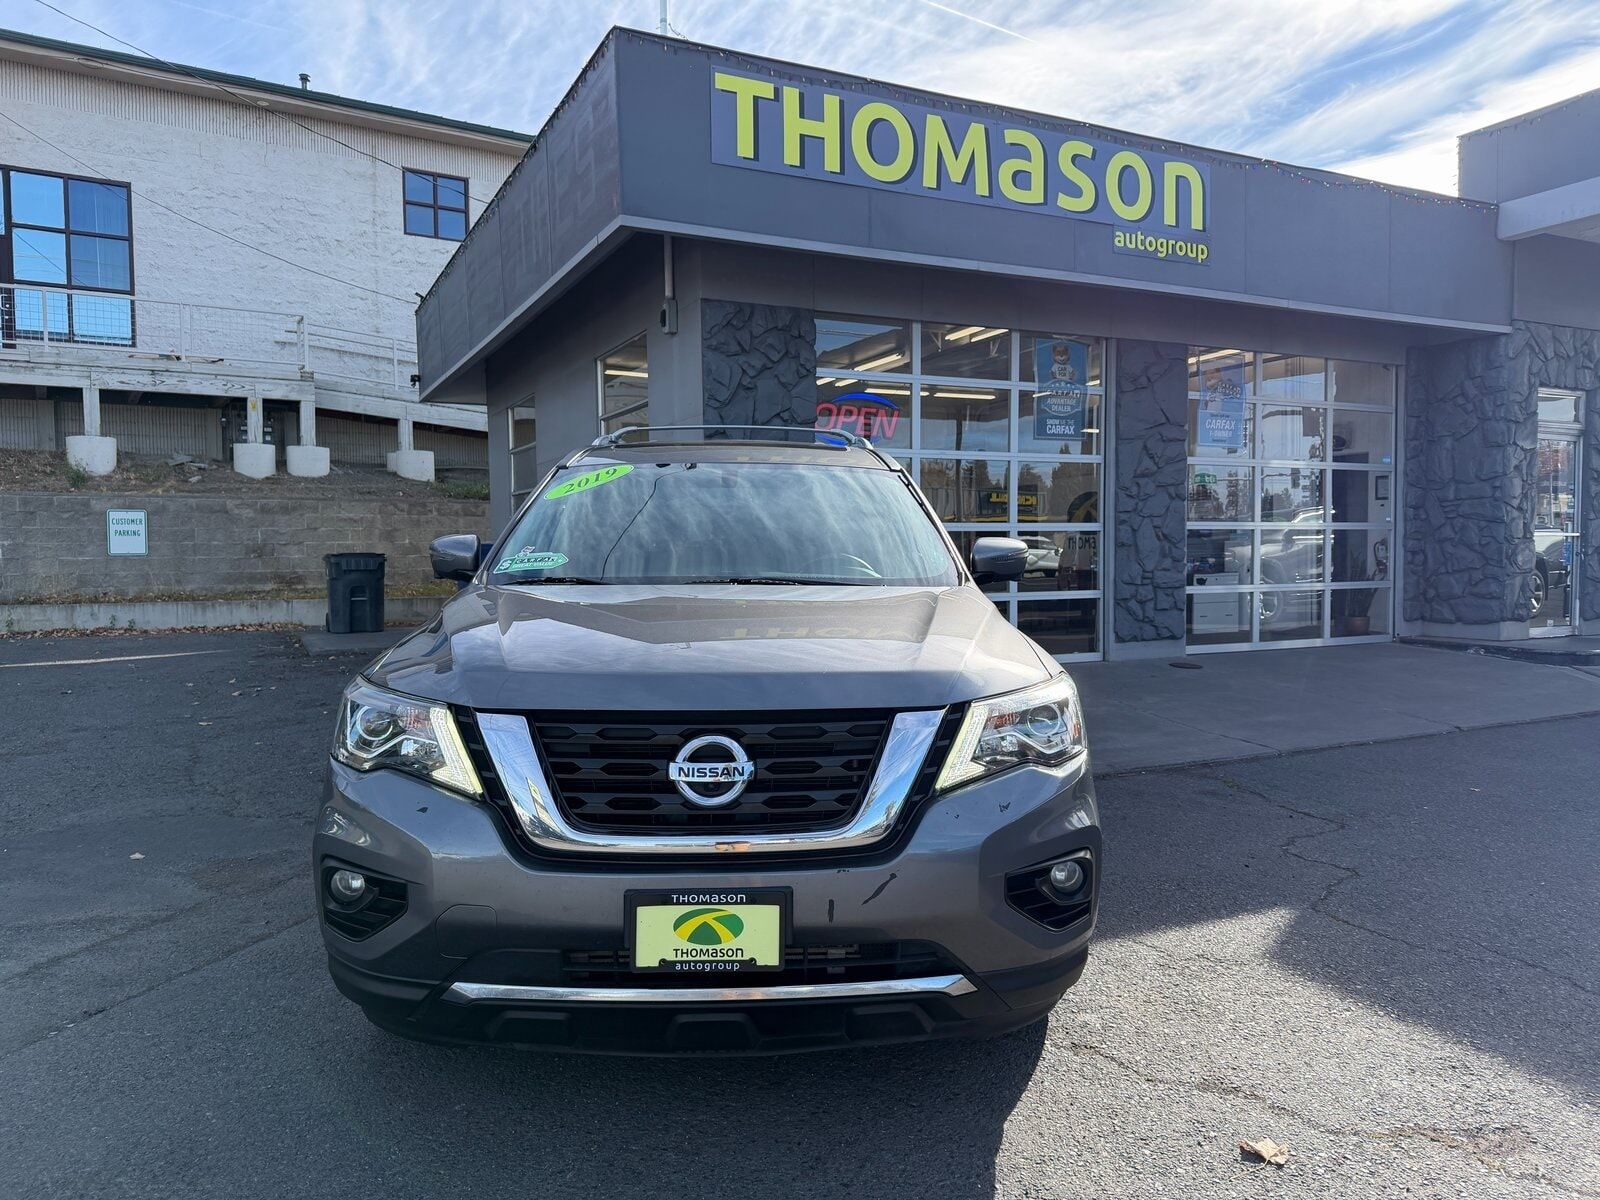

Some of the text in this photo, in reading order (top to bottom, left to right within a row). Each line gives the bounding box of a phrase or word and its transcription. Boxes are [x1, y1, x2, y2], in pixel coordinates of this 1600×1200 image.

[1114, 228, 1209, 263] autogroup
[815, 403, 902, 439] OPEN
[1205, 419, 1236, 430] CARFAX
[1046, 425, 1075, 434] CARFAX
[563, 468, 618, 494] 2019
[678, 766, 745, 779] NISSAN
[675, 962, 740, 971] autogroup
